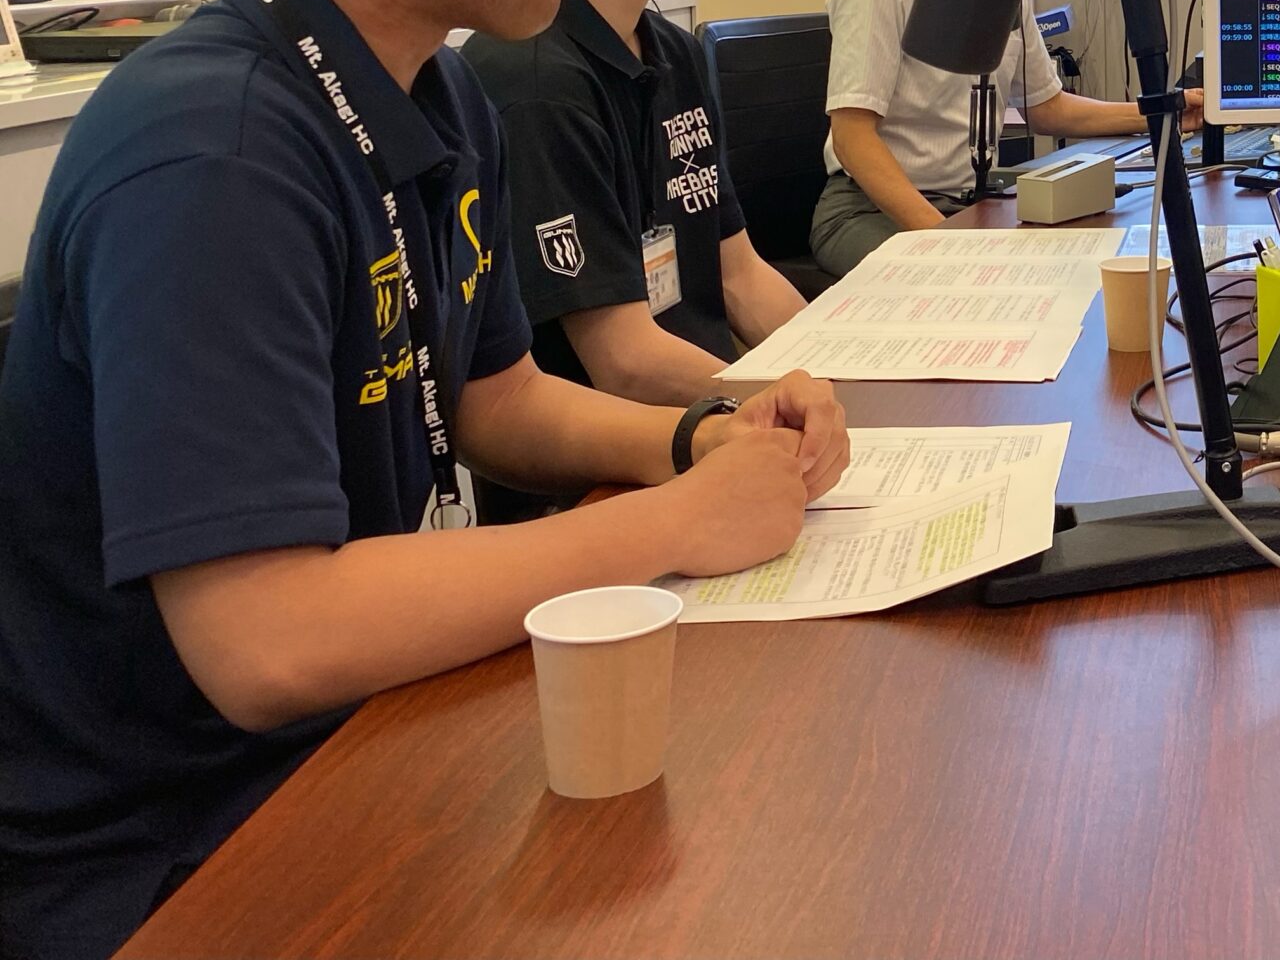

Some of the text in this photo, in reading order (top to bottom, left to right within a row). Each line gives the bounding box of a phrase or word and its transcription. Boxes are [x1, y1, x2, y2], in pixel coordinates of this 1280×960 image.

[297, 36, 374, 155] Mt. Akagi HC
[666, 164, 719, 200] MAEBAS
[683, 184, 719, 214] CITY
[392, 228, 412, 279] Akagi
[405, 279, 418, 310] HC
[416, 345, 449, 456] Mt. Akagi HC
